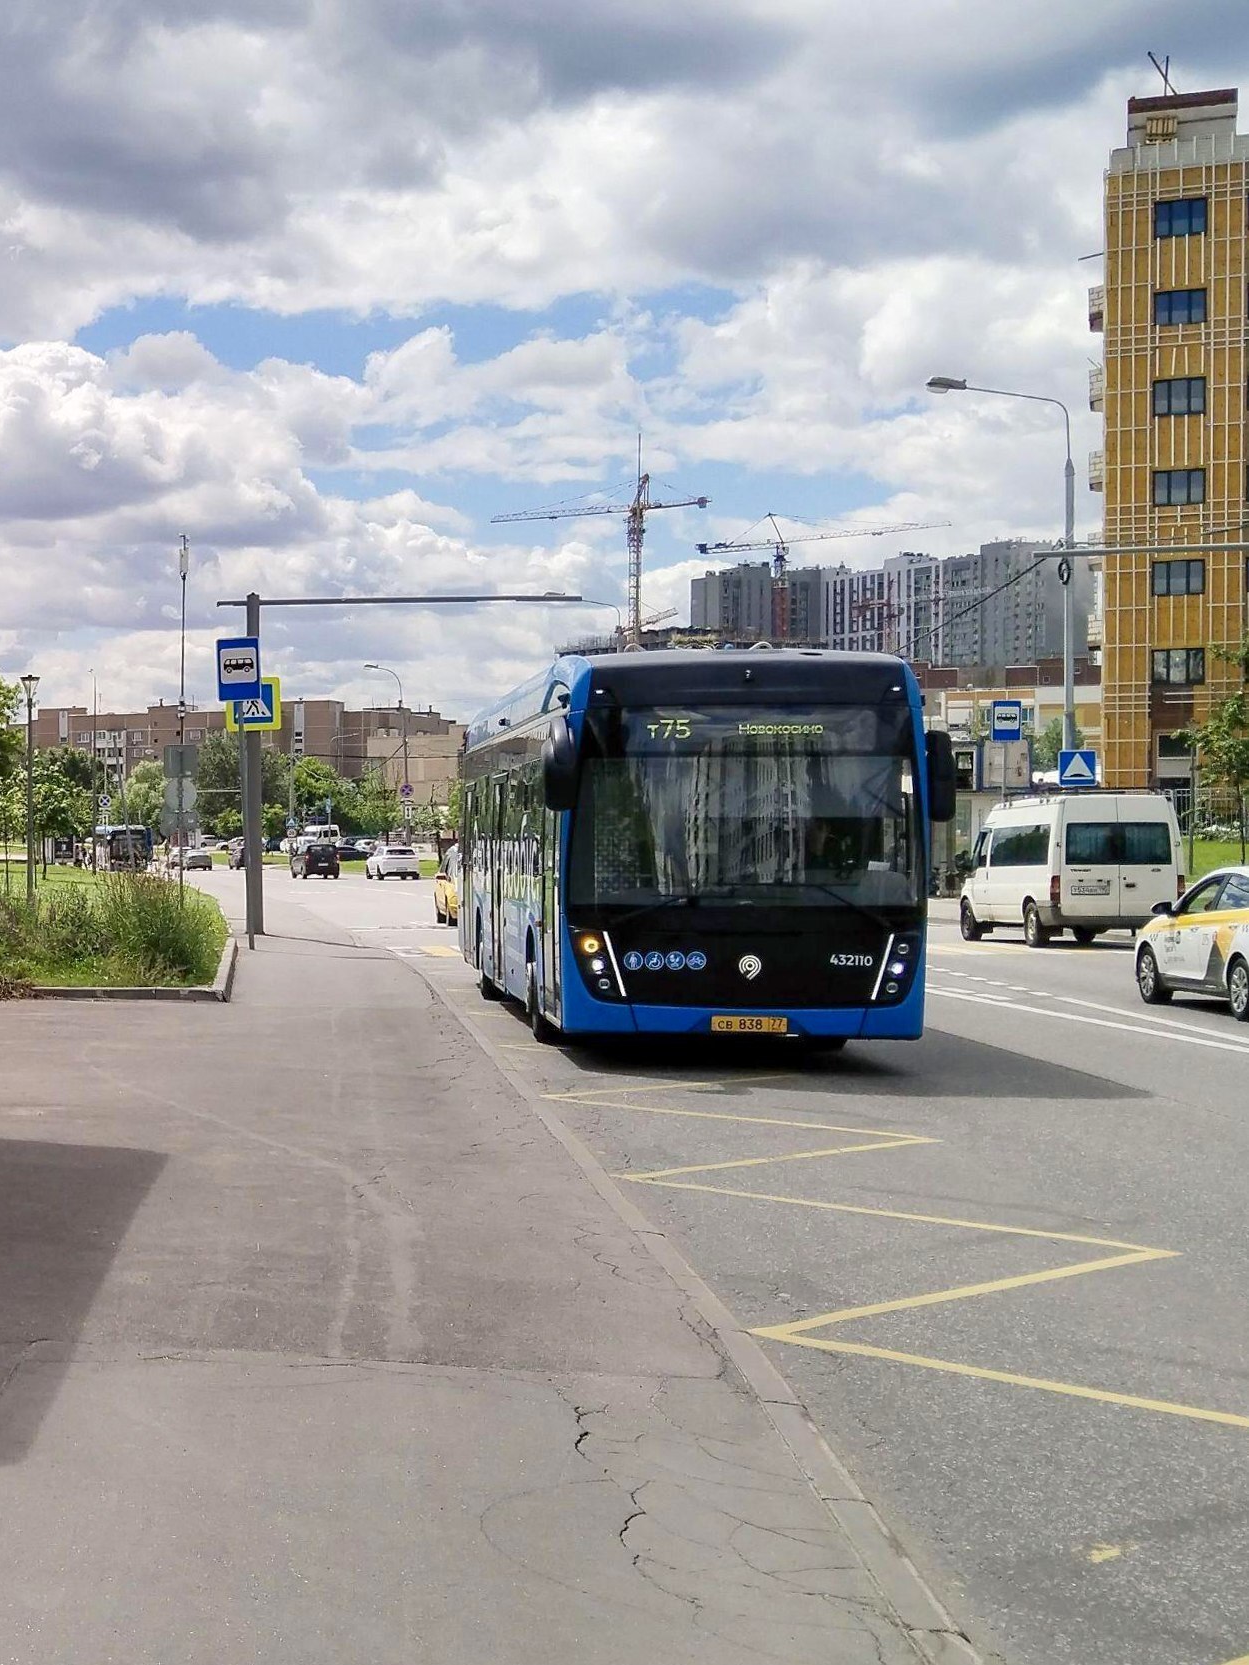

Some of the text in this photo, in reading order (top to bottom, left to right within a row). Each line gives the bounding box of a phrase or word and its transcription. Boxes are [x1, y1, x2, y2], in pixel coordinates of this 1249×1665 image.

[738, 723, 823, 735] Новокосино
[829, 954, 873, 967] 432110
[739, 1018, 763, 1030] 838
